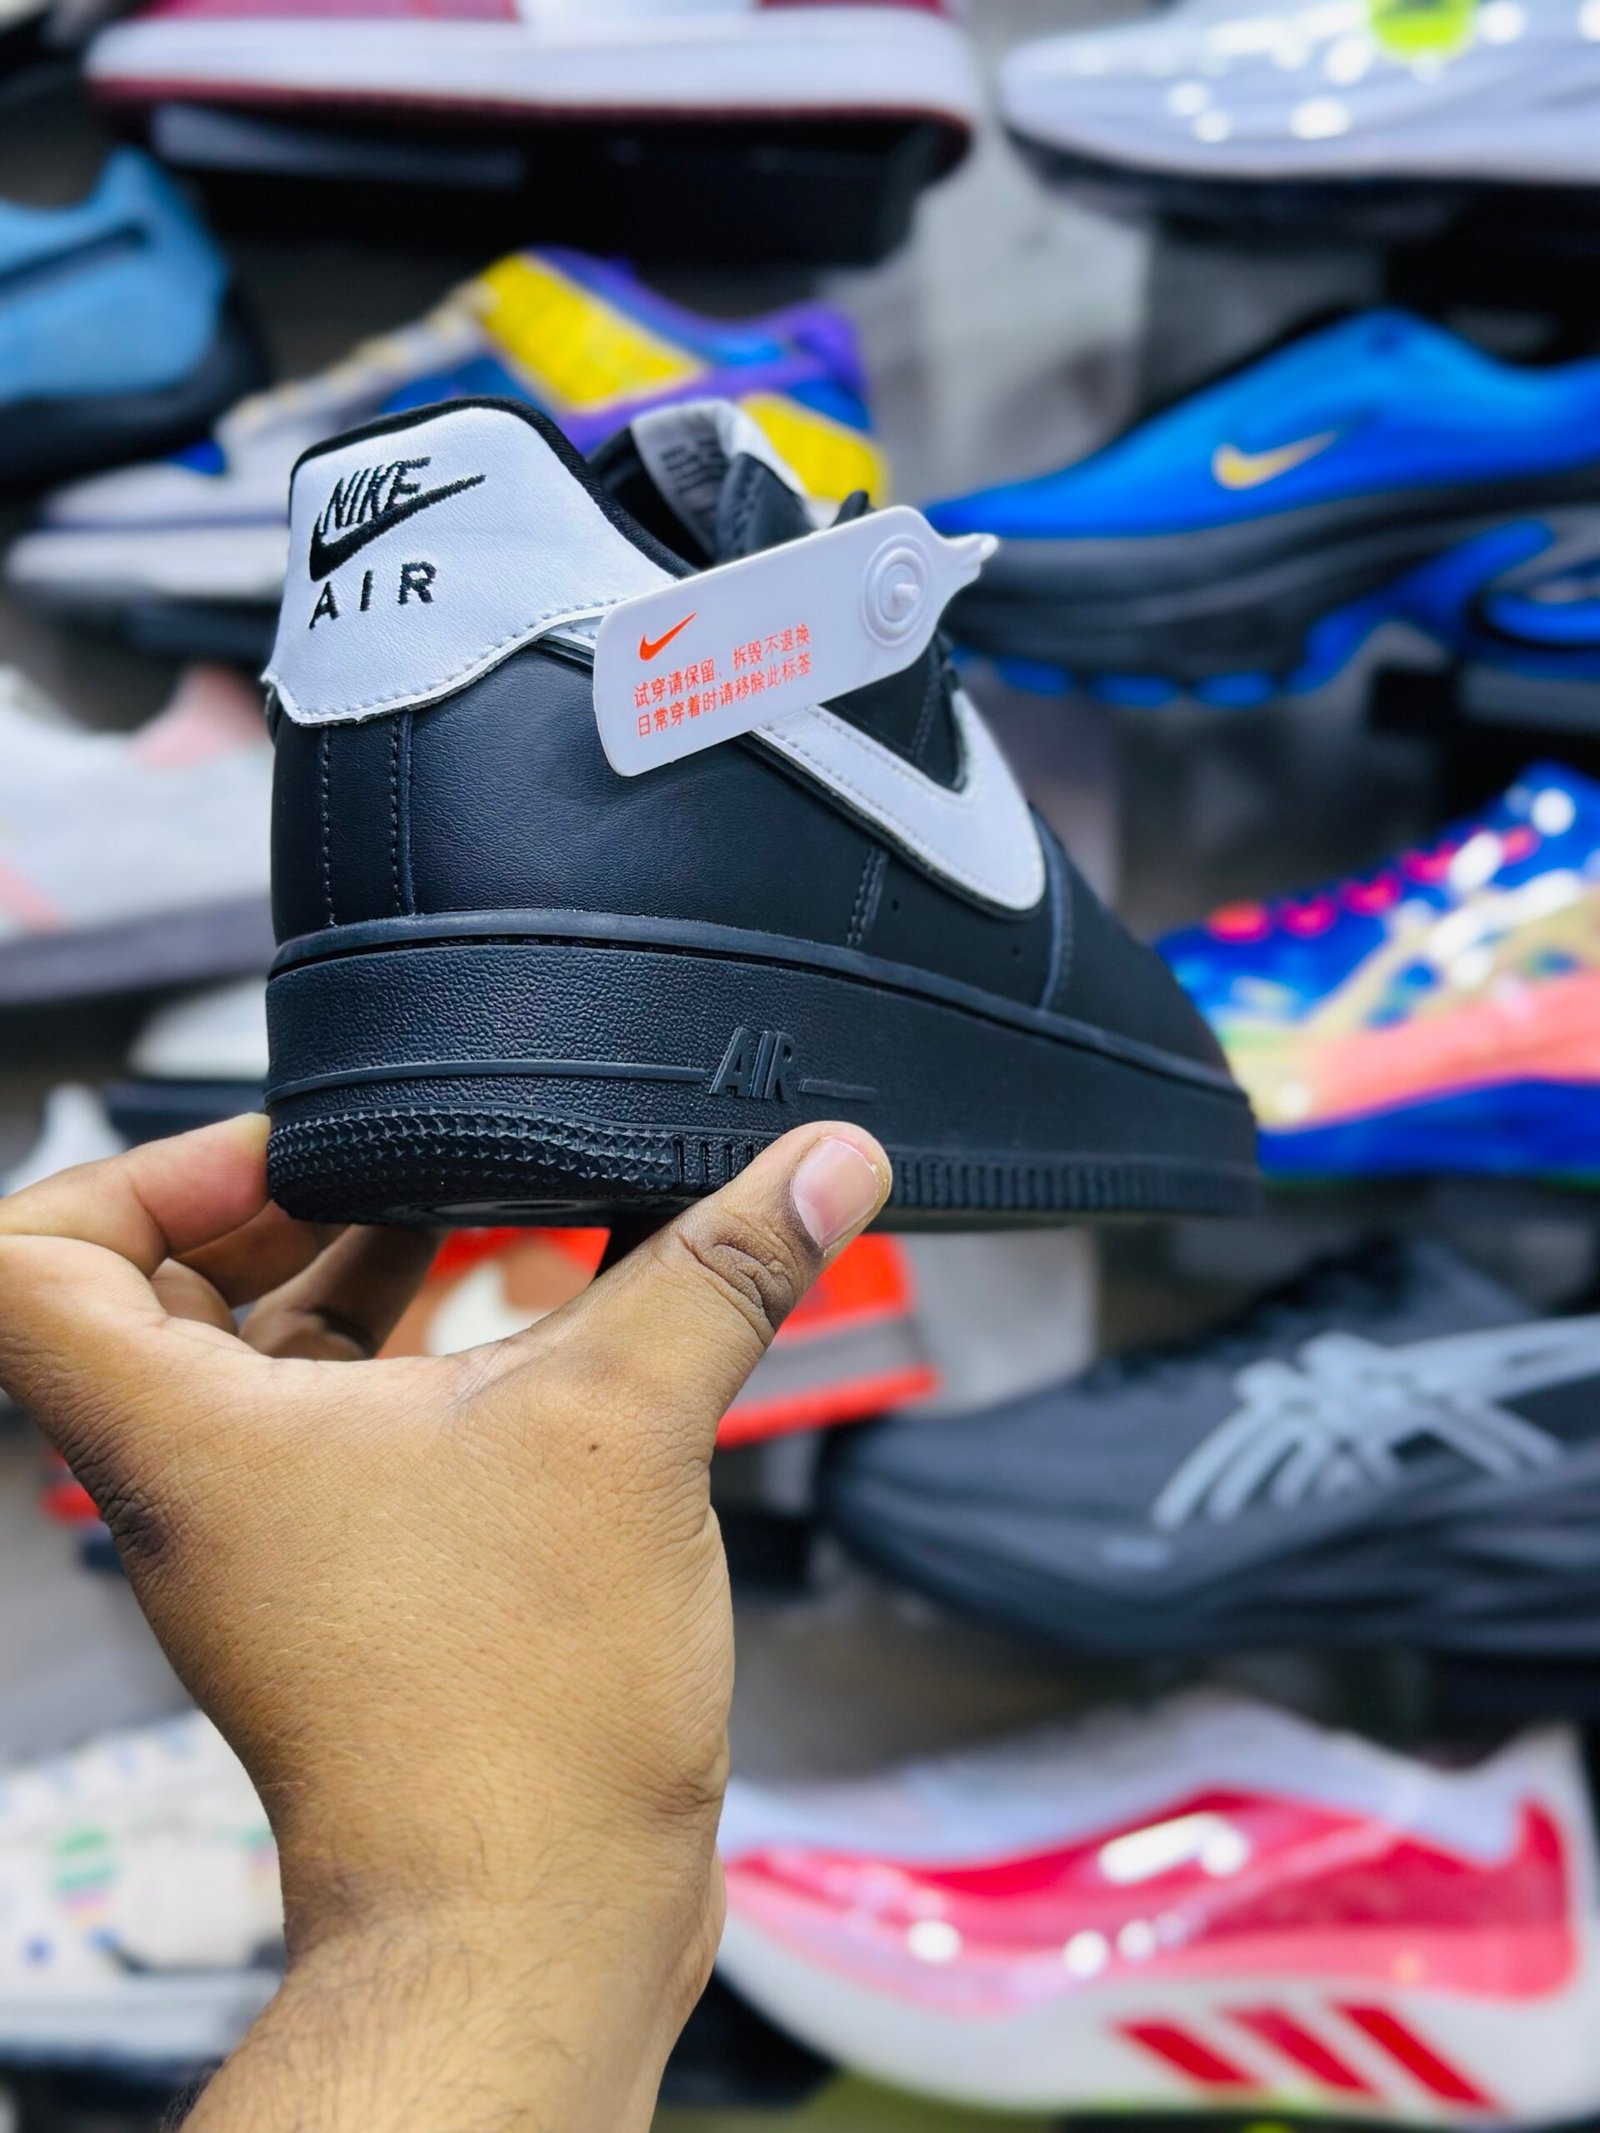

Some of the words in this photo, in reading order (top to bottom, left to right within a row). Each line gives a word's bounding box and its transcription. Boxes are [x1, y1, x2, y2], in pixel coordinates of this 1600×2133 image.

[315, 456, 431, 536] NIKE
[309, 561, 436, 629] AIR
[637, 652, 812, 737] 日常穿着时请移除此标签
[709, 1026, 797, 1102] AIR
